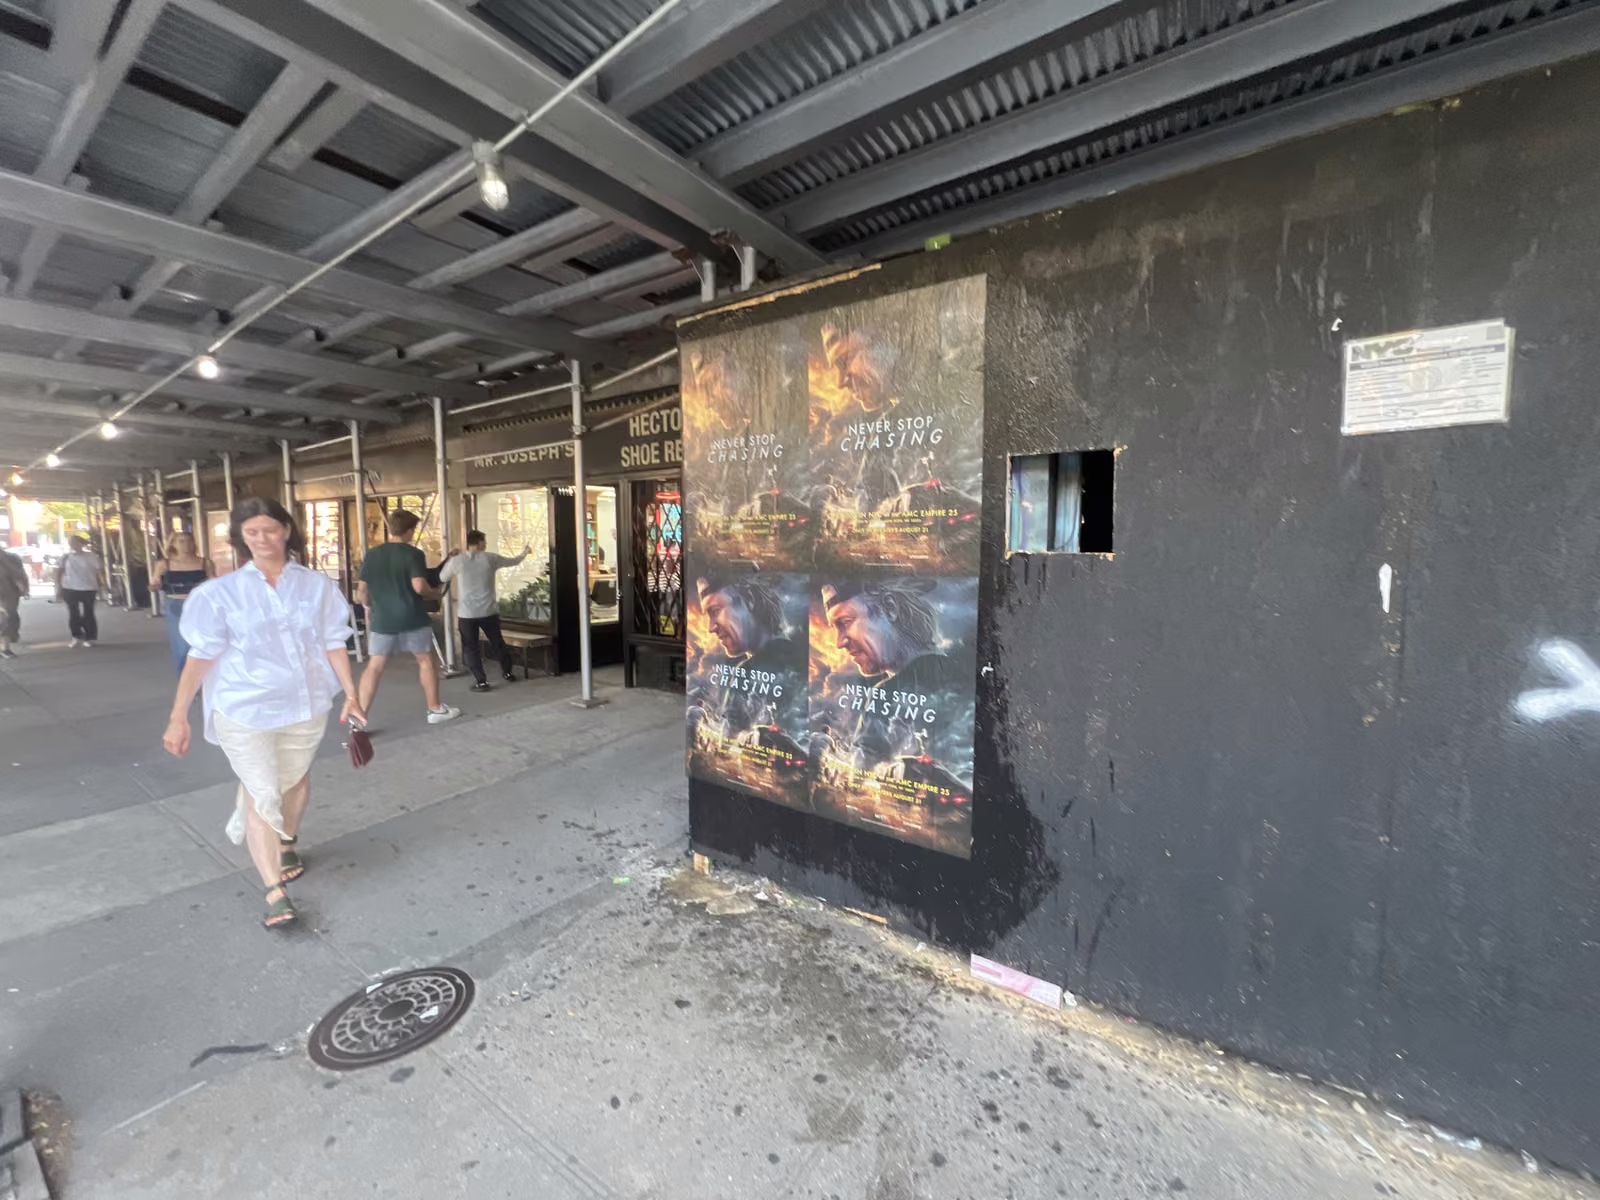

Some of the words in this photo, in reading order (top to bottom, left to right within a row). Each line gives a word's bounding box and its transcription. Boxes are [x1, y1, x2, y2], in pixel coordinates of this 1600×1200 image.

[629, 407, 681, 437] HECTO
[848, 420, 891, 435] NEVER
[897, 415, 934, 431] STOP
[711, 437, 745, 450] NEVER
[749, 433, 776, 446] STOP
[840, 428, 944, 452] CHASING
[501, 444, 575, 465] JOSEPH'S
[620, 442, 660, 468] SHOE
[707, 444, 784, 464] CHASING
[920, 509, 947, 517] EMPIRE
[714, 663, 747, 678] NEVER
[750, 669, 777, 683] STOP
[709, 673, 783, 698] CHASING
[846, 683, 887, 701] NEVER
[892, 690, 928, 707] STOP
[838, 695, 936, 723] CHASING
[913, 781, 939, 794] EMPIRE
